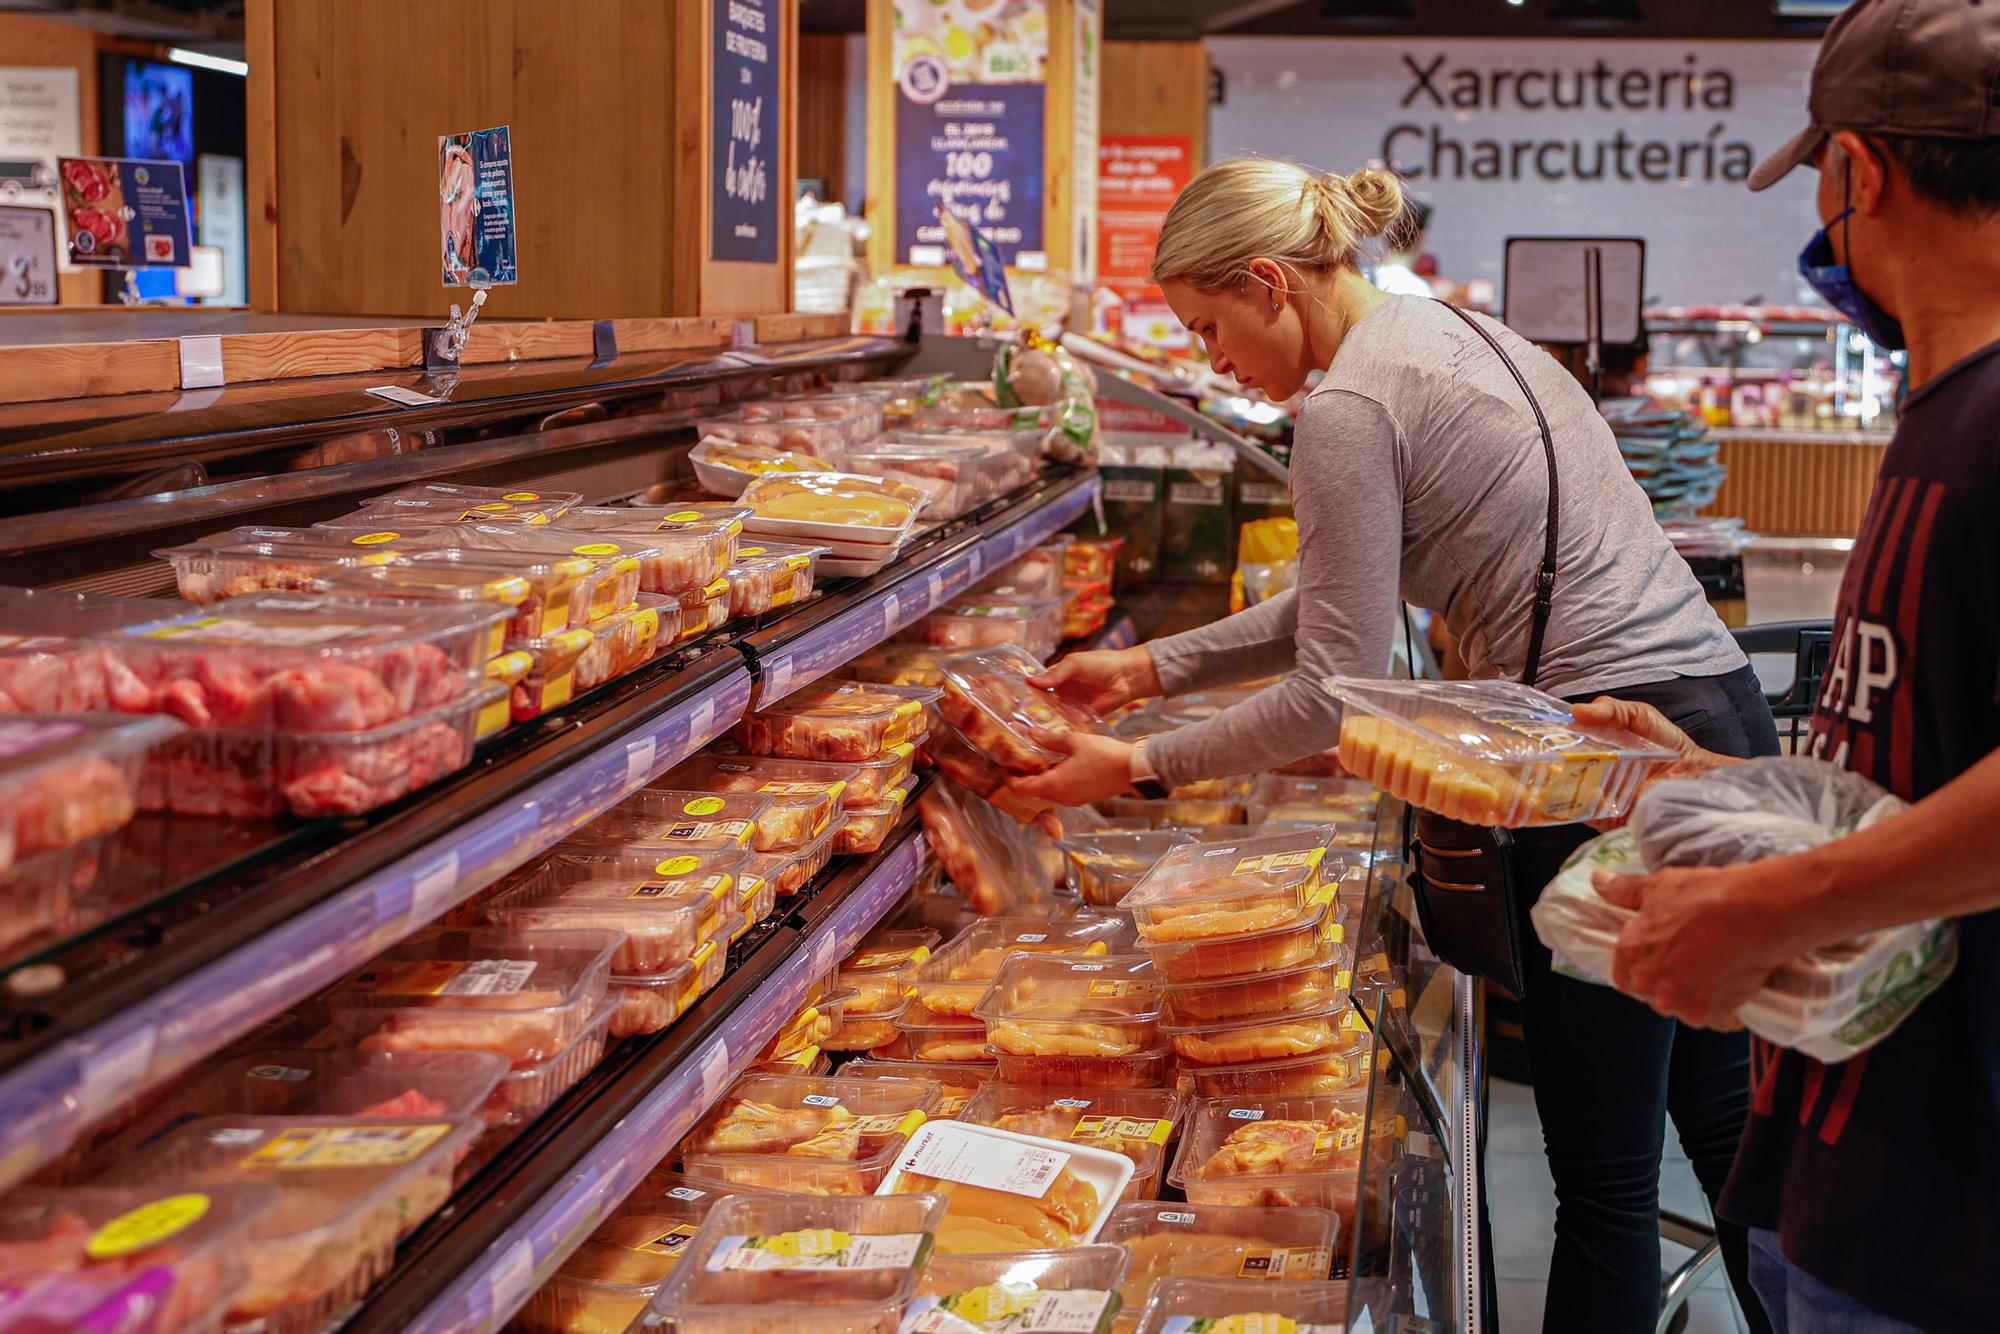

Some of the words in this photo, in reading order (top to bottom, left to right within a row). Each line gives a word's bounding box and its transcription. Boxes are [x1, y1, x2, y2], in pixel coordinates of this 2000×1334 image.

[1402, 52, 1735, 109] Xarcuteria
[945, 151, 993, 179] 100
[1381, 121, 1754, 182] Charcutería
[913, 1131, 936, 1159] market
